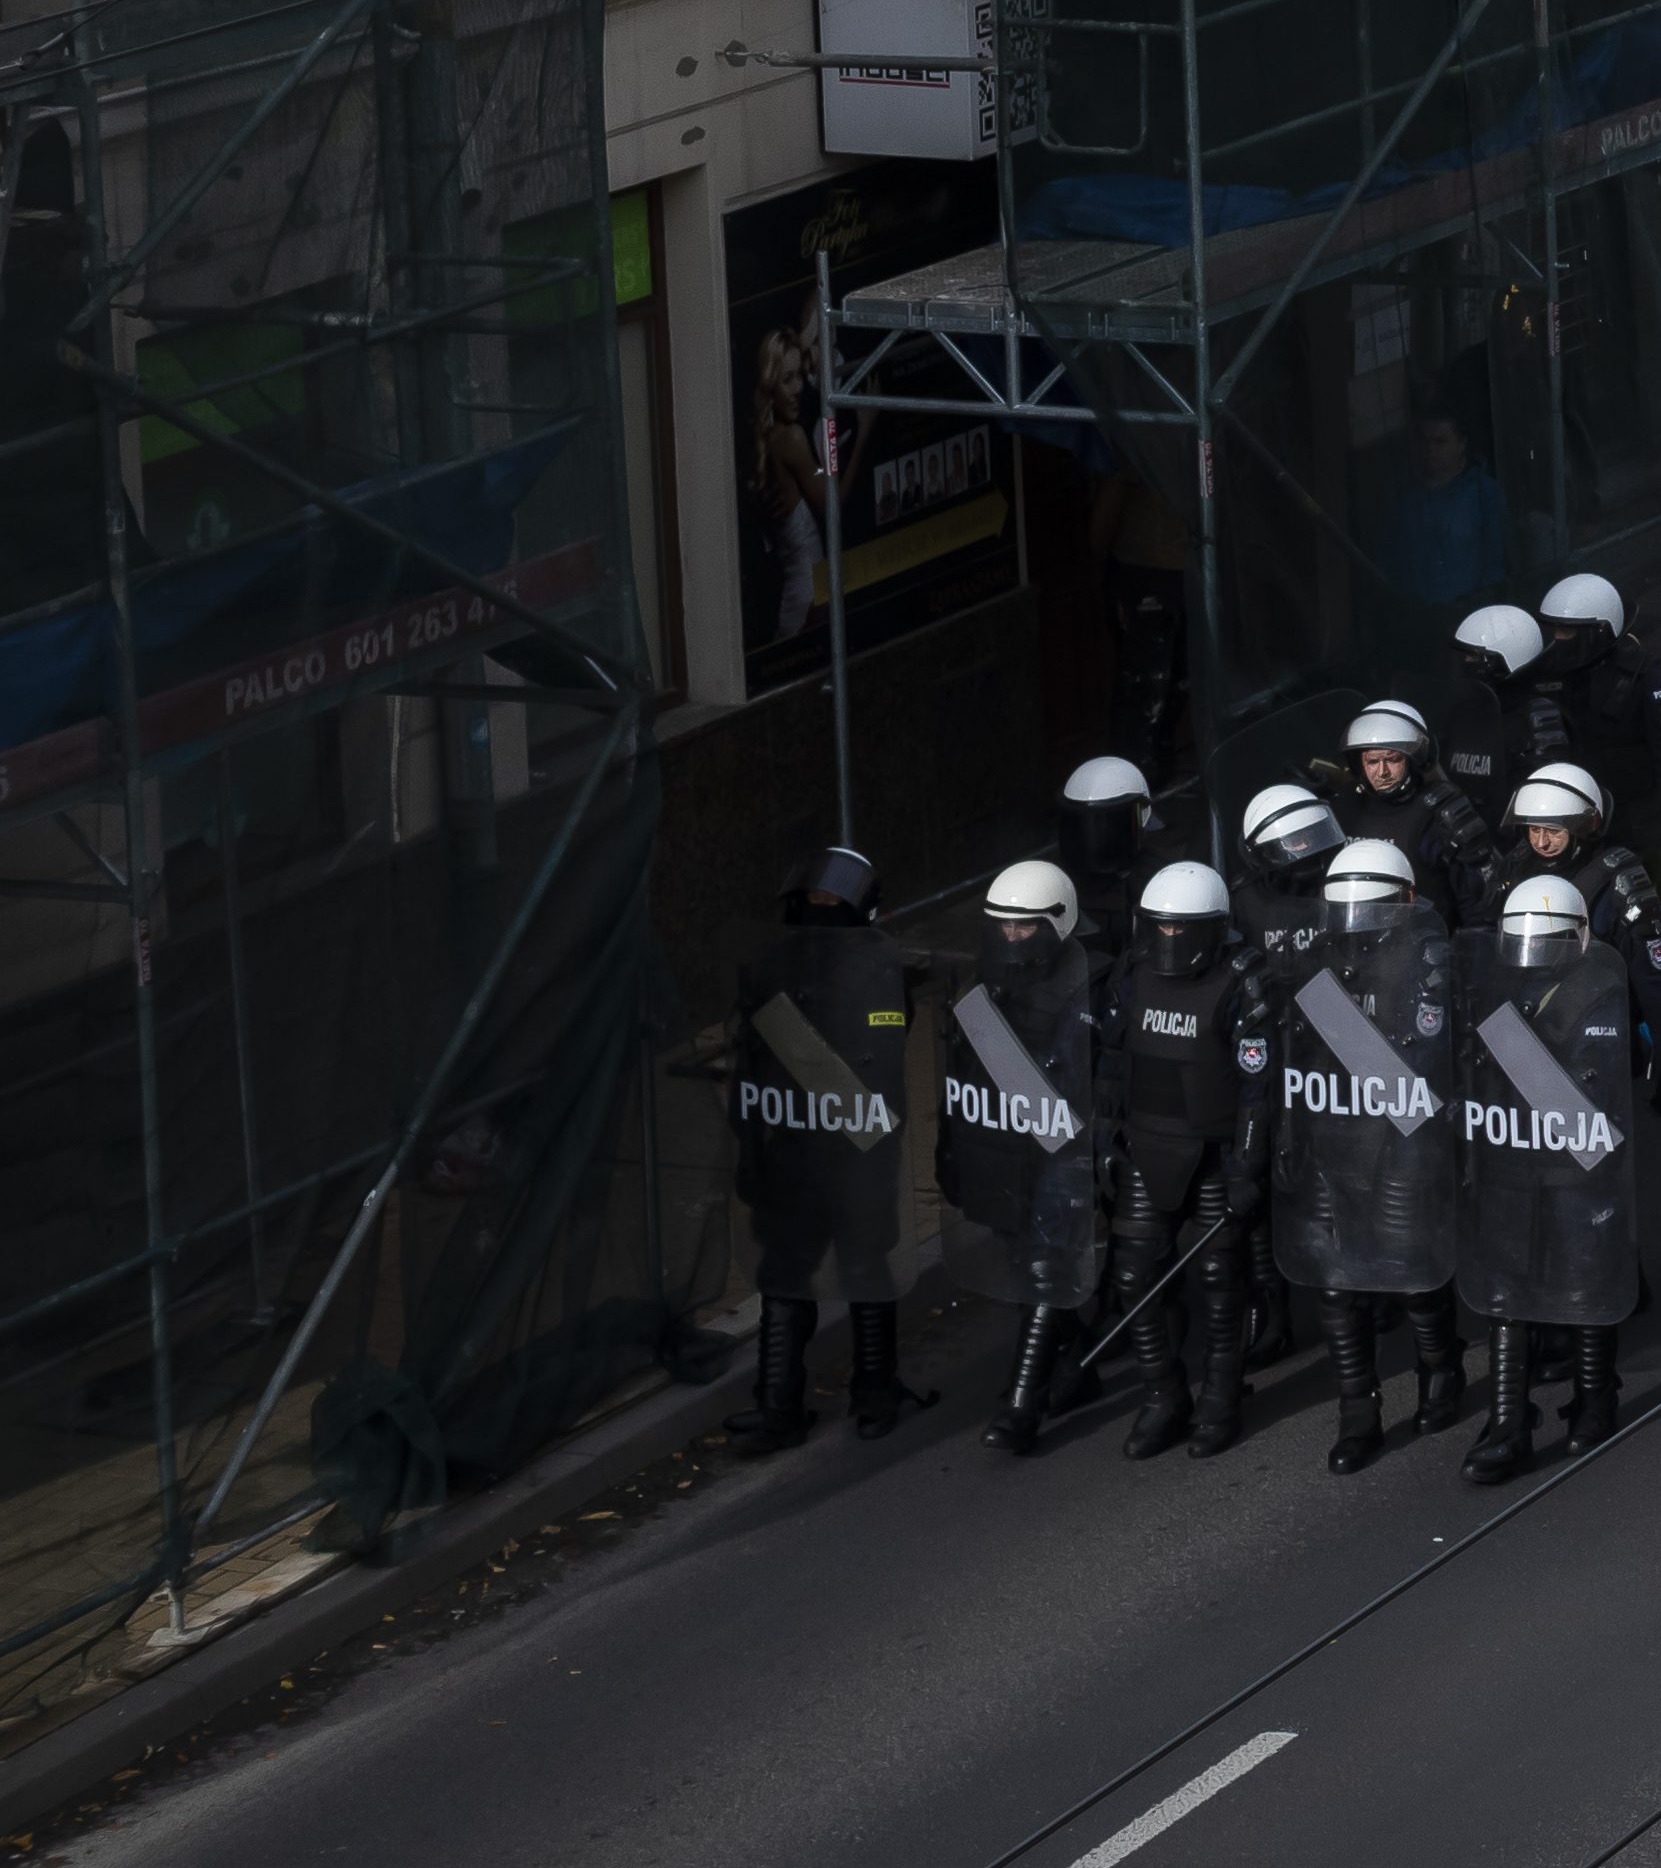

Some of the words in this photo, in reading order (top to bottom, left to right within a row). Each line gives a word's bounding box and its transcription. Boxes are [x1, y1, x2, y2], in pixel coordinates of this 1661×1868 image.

[830, 437, 840, 474] DELTA
[225, 632, 327, 716] PALCO
[345, 618, 403, 670] 601
[407, 600, 460, 643] 263
[1450, 752, 1491, 776] POLICJA
[1143, 1008, 1197, 1038] POLICJA
[1585, 1026, 1617, 1037] POLICJA
[740, 1081, 891, 1133] POLICJA
[944, 1076, 1075, 1139] POLICJA
[1284, 1068, 1433, 1117] POLICJA
[1466, 1101, 1614, 1153] POLICJA
